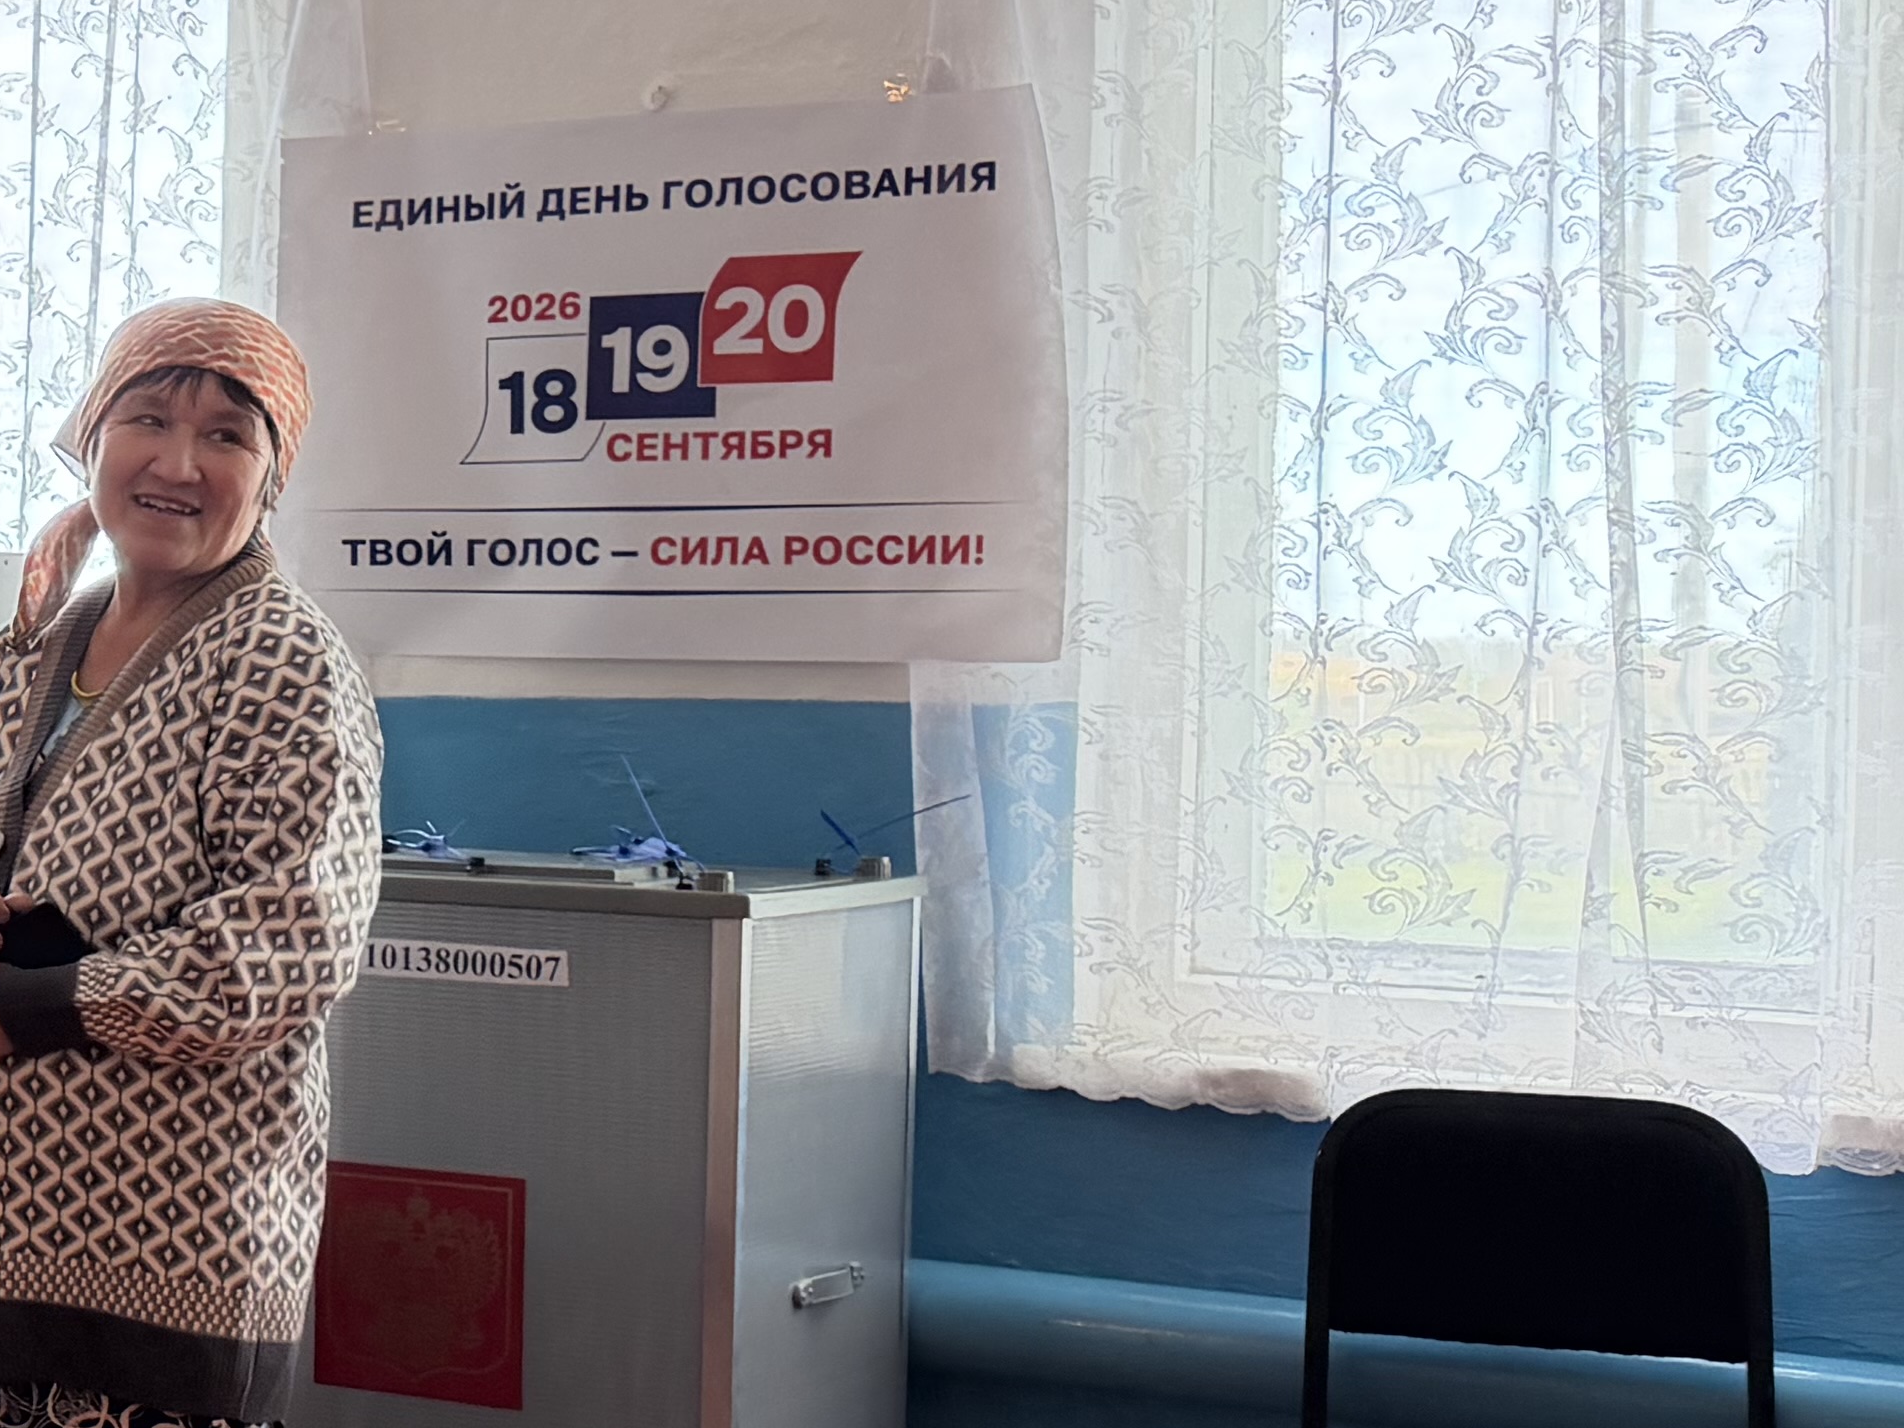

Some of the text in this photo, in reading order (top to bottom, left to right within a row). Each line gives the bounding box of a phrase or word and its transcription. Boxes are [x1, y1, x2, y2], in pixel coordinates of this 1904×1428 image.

[352, 160, 997, 232] ЕДИНЫЙ ДЕНЬ ГОЛОСОВАНИЯ
[488, 291, 581, 324] 2026
[499, 286, 826, 435] 18 19 20
[606, 428, 833, 463] СЕНТЯБРЯ
[342, 530, 453, 568] ТВОЙ
[466, 536, 600, 568] ГОЛОС
[650, 536, 769, 566] СИЛА
[785, 535, 985, 566] РОССИИ!
[366, 942, 562, 983] 10138000507
